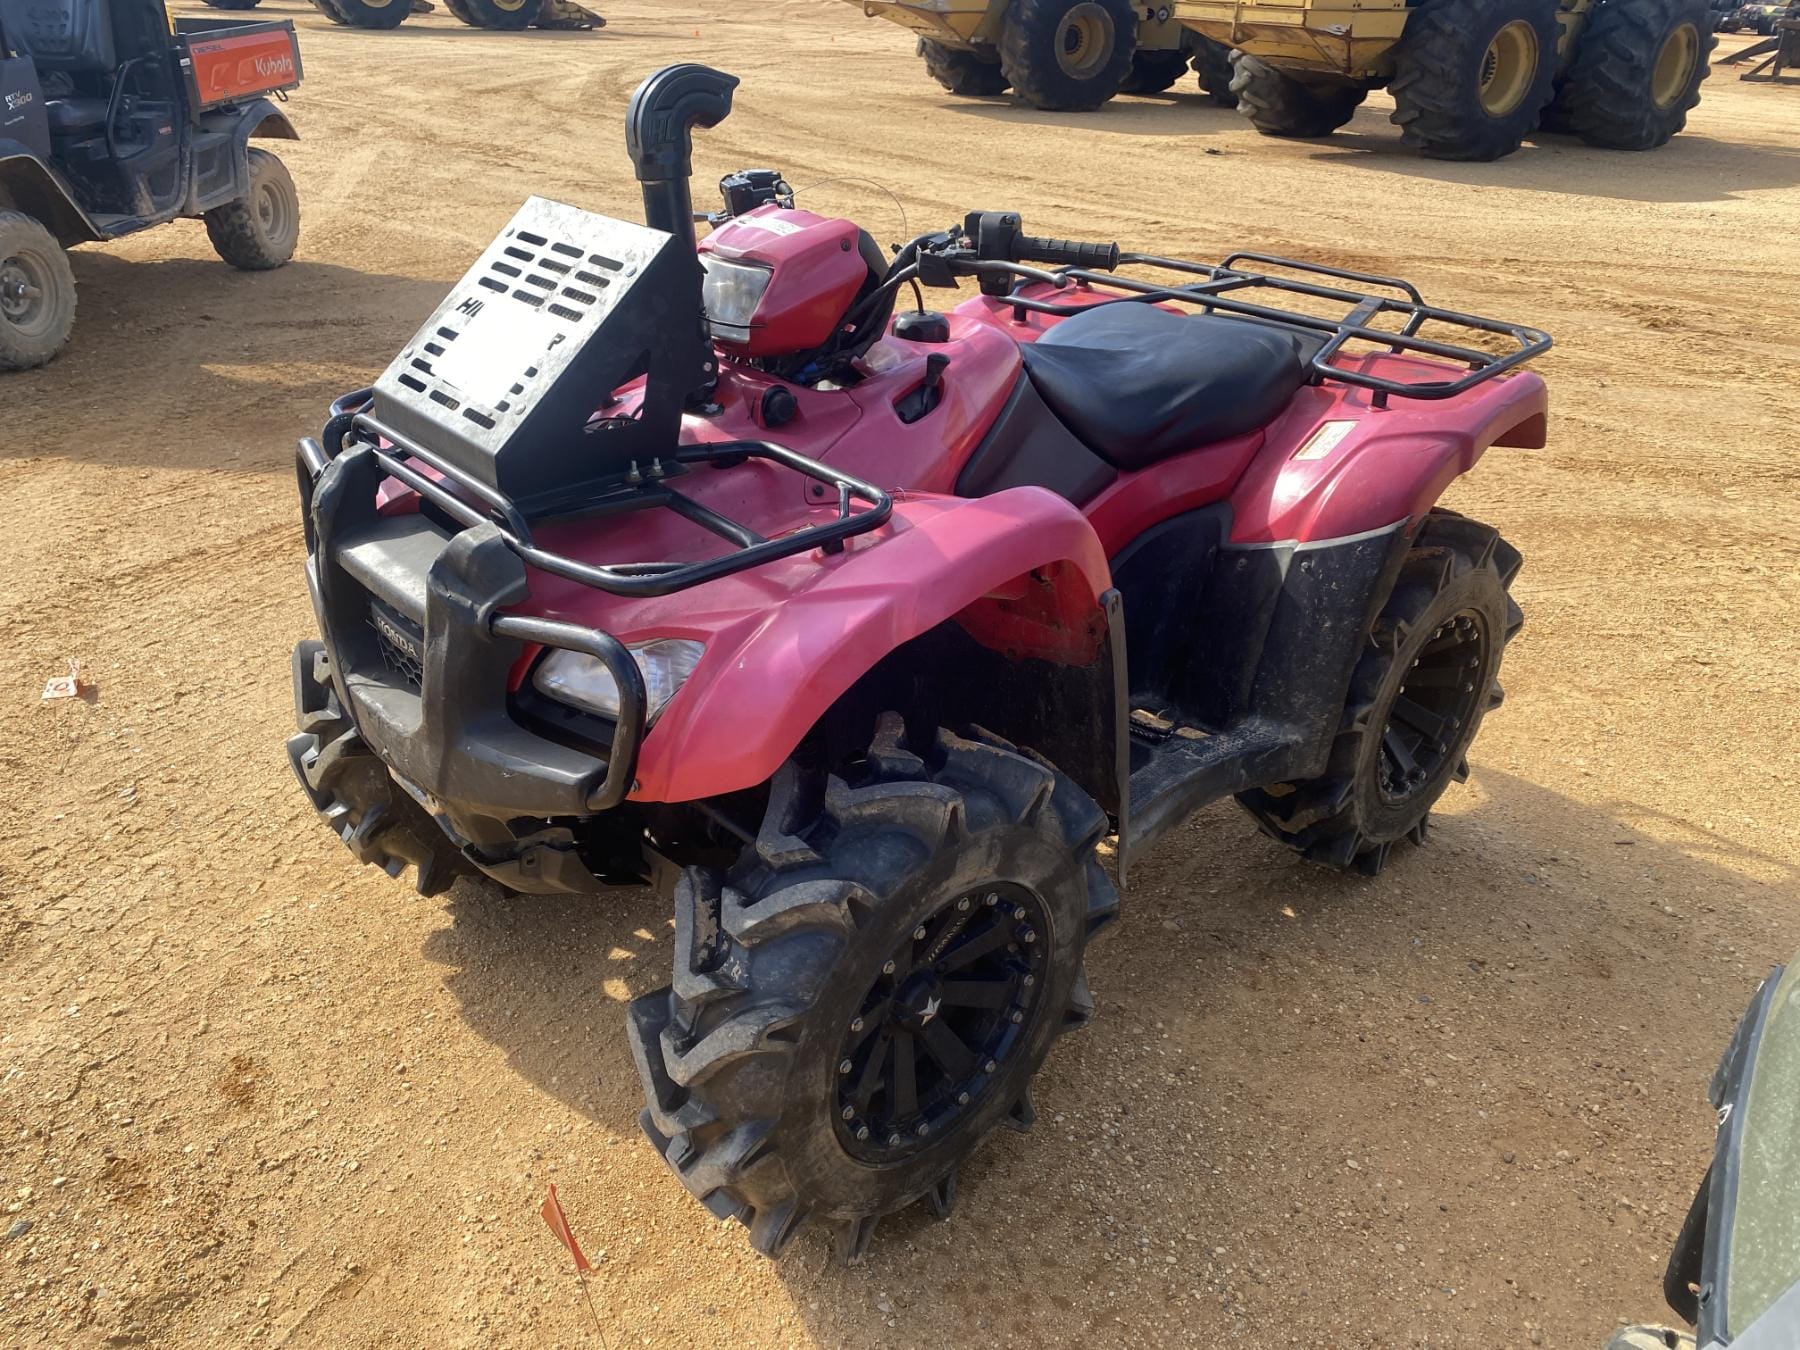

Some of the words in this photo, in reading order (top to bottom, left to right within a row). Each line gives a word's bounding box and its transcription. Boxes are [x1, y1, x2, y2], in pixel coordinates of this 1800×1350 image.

[255, 54, 293, 76] Kubota
[4, 90, 20, 103] RTV
[377, 616, 419, 658] HONDA
